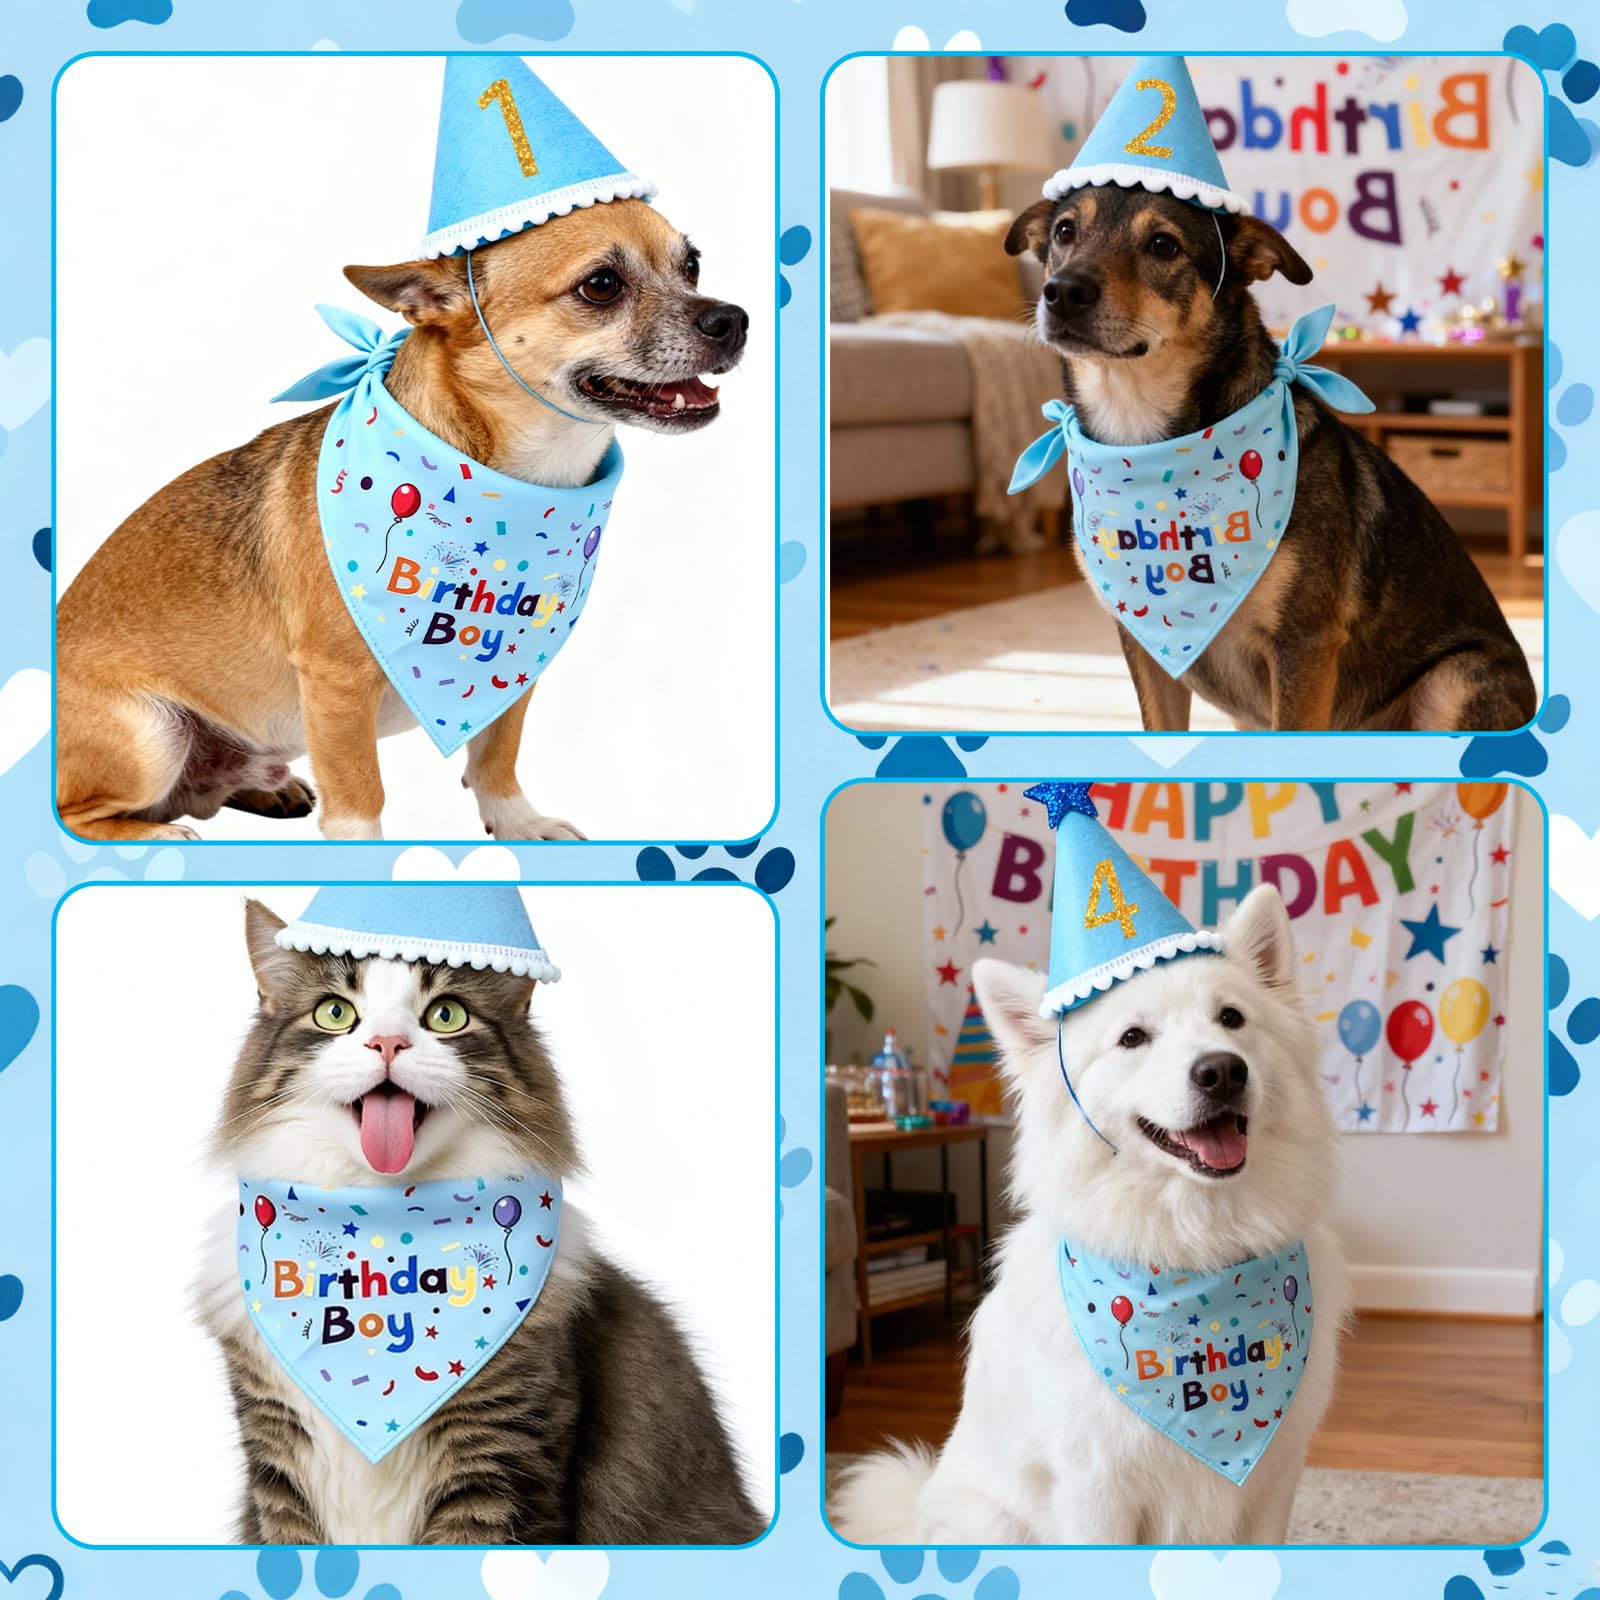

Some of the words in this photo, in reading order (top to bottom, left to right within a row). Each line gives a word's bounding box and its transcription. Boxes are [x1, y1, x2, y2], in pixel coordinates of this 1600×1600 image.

[477, 77, 539, 178] 1
[1124, 78, 1177, 159] 2
[387, 556, 560, 628] Birthday
[422, 611, 504, 663] Boy
[991, 811, 1416, 926] BTHDAY
[1084, 858, 1140, 940] 4
[273, 1254, 477, 1307] Birthday
[322, 1305, 414, 1354] Boy
[1135, 1334, 1283, 1381] Birthday
[1182, 1379, 1250, 1413] Boy
